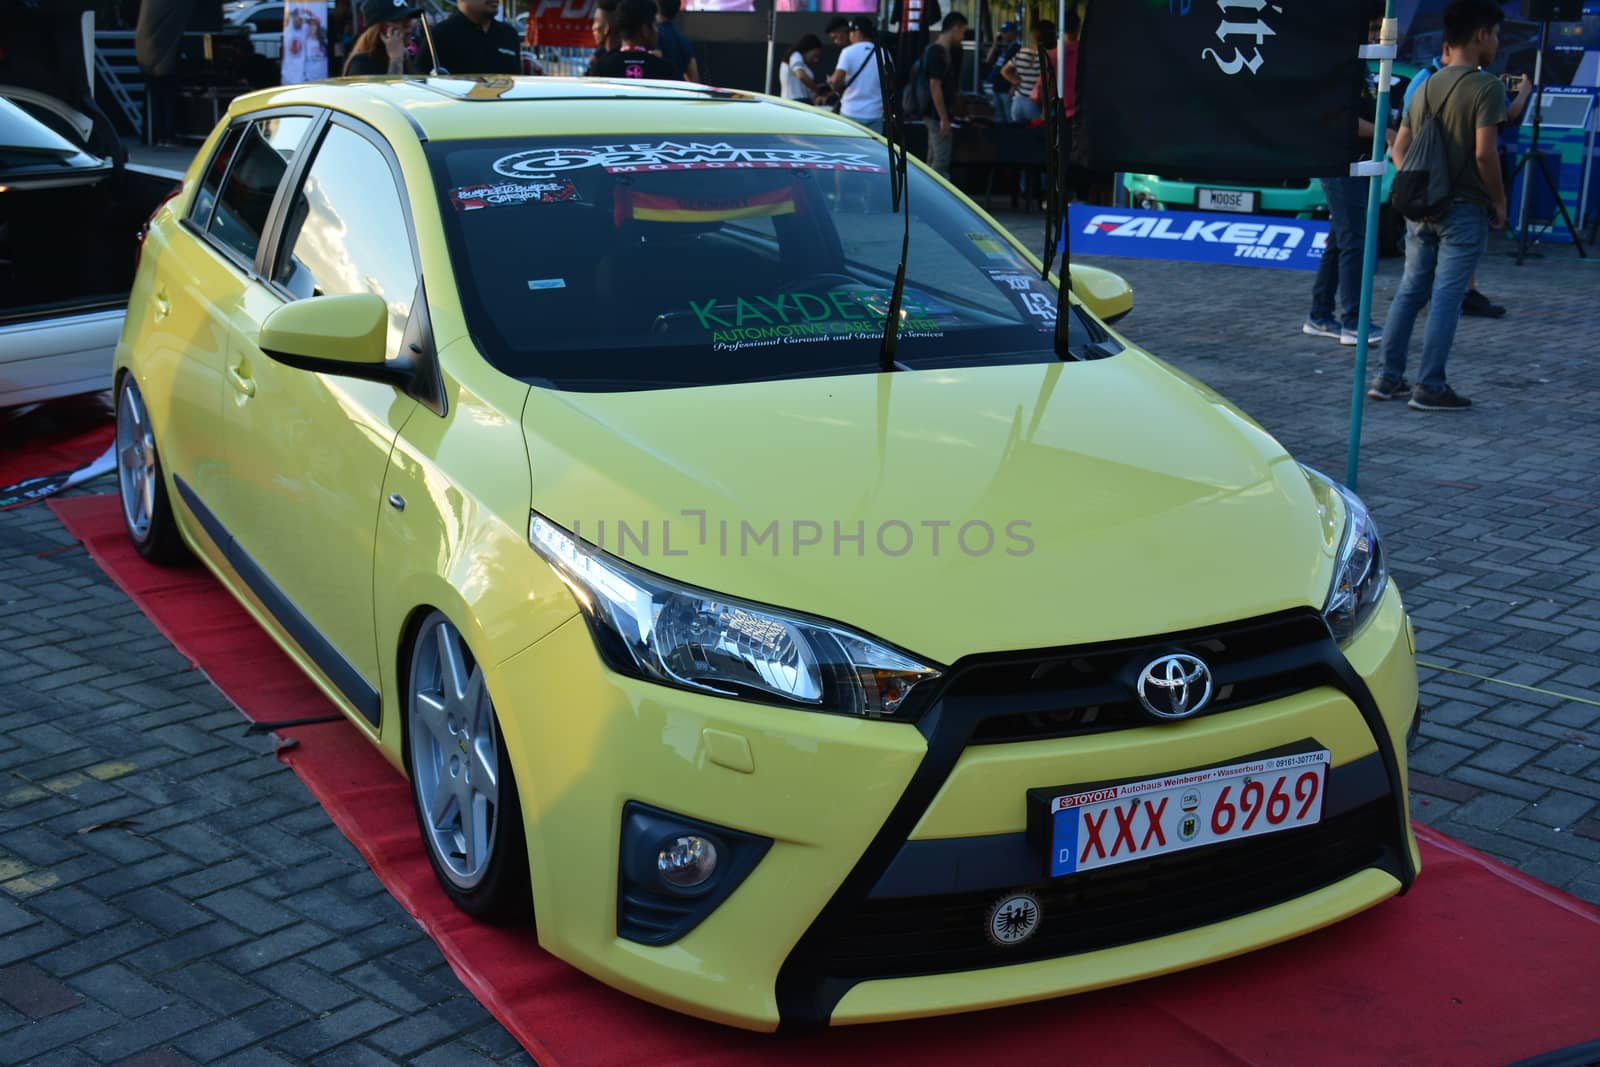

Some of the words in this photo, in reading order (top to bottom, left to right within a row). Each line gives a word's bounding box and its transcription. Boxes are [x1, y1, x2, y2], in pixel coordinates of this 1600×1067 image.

[592, 141, 734, 155] TEAM
[612, 161, 881, 173] MOTORSPORT
[1210, 191, 1243, 207] MOOSE
[1083, 214, 1305, 249] FALKEN
[1234, 244, 1293, 261] TIRES
[713, 321, 826, 342] AUTOMOTIVE
[829, 319, 873, 334] CARE
[713, 337, 781, 352] Professional
[784, 333, 831, 345] Carwash
[832, 330, 852, 341] and
[904, 329, 944, 339] Services
[1074, 790, 1116, 806] TOYOTA
[1120, 781, 1162, 795] Autohaus
[1164, 772, 1211, 787] Weinberger
[1217, 763, 1264, 778] Wasserburg
[1080, 796, 1168, 864] XXX
[1211, 771, 1320, 836] 6969
[1058, 848, 1069, 863] D
